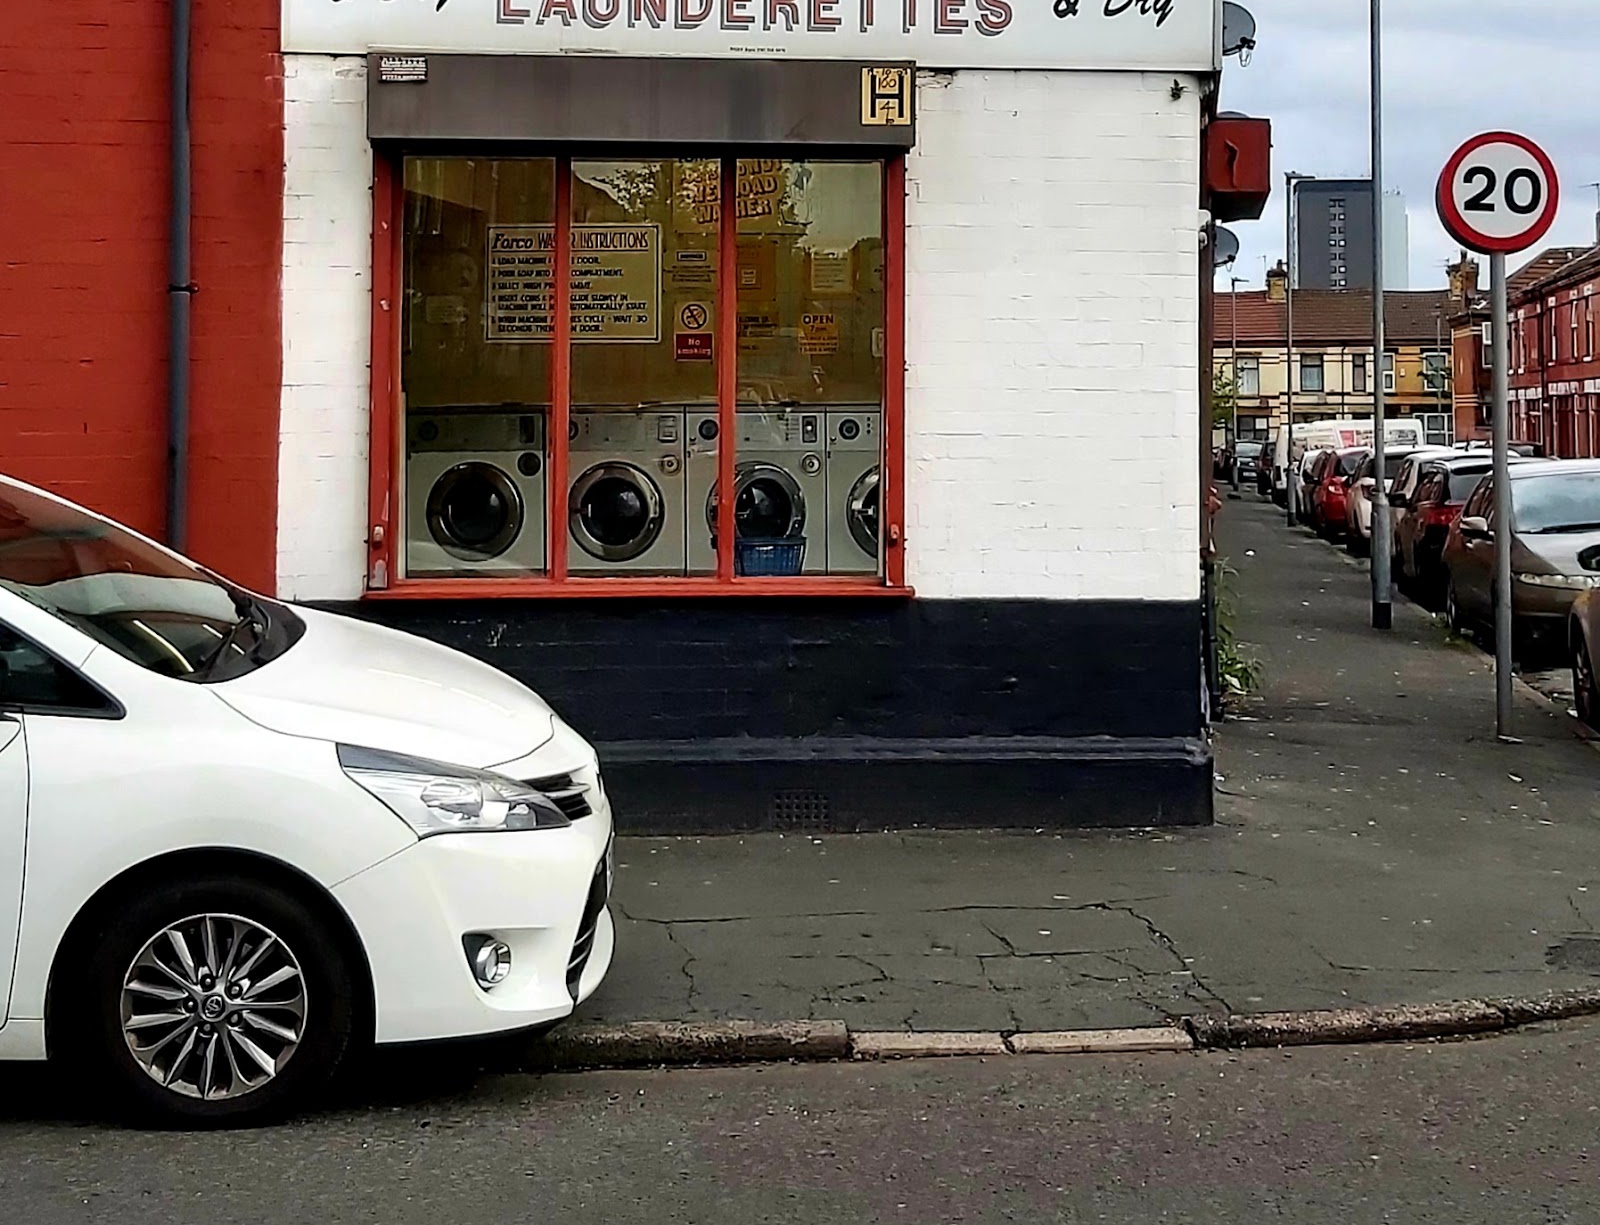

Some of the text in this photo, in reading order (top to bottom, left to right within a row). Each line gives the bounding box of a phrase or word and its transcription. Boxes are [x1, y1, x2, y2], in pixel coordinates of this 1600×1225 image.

[870, 73, 905, 119] H
[1463, 165, 1541, 215] 20
[580, 232, 649, 249] INSTRUCTIONS
[584, 315, 605, 323] CYCLE
[803, 315, 834, 325] OPEN
[688, 338, 701, 346] No
[678, 347, 711, 356] smoking
